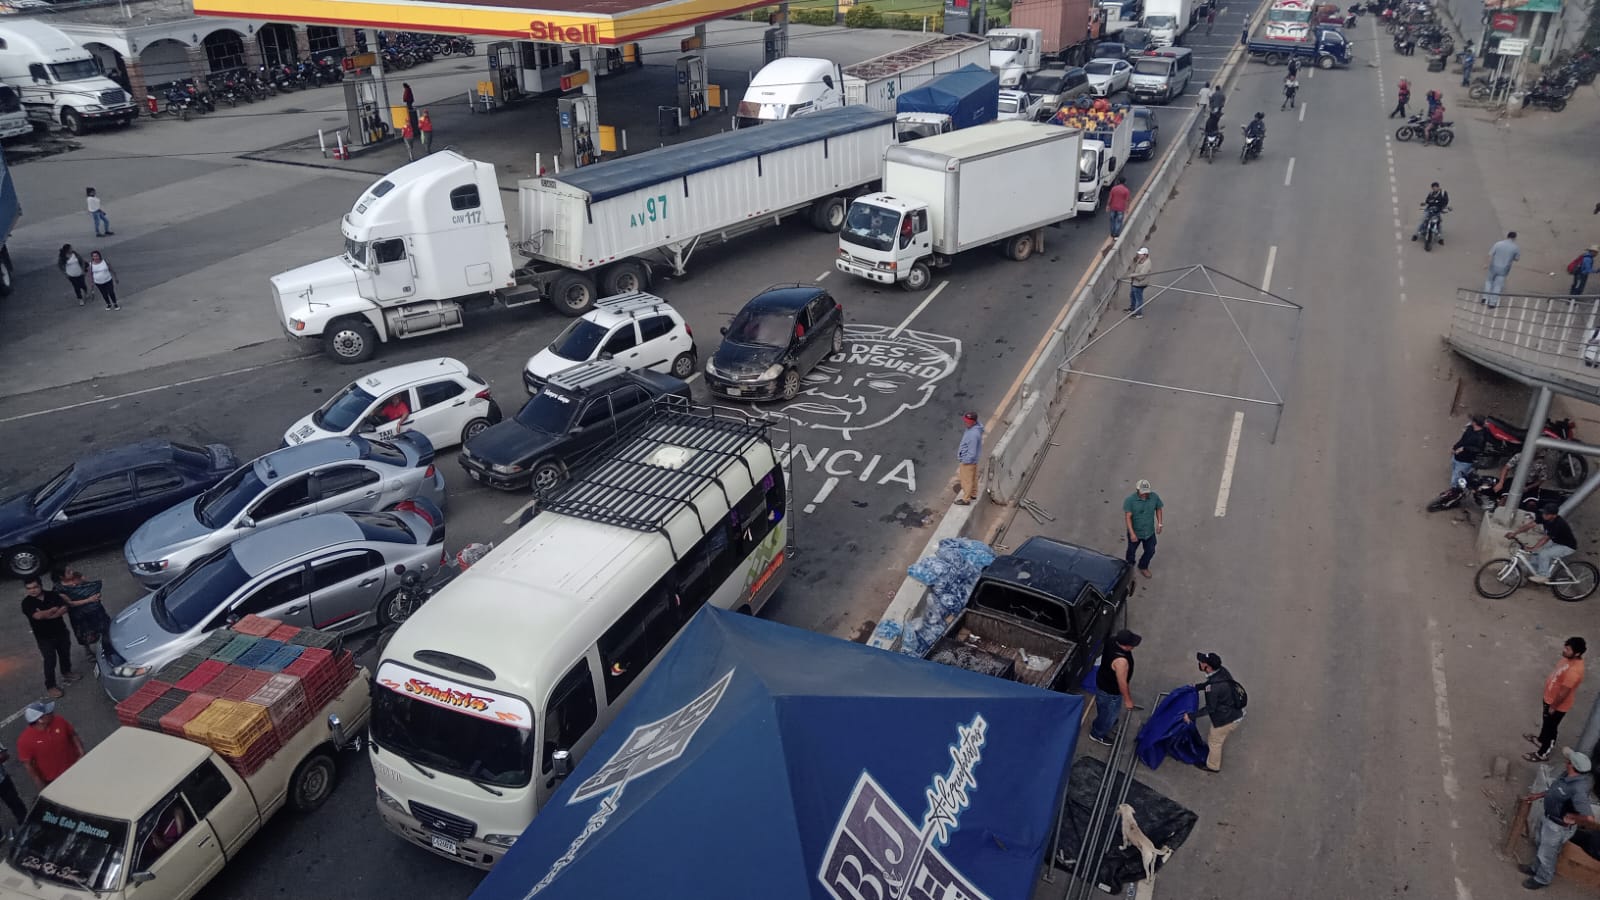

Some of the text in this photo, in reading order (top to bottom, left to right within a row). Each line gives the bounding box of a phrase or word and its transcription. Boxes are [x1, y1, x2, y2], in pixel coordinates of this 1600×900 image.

[529, 20, 598, 44] Shell
[452, 210, 482, 224] CAV 117
[630, 194, 667, 228] AV 97
[828, 352, 942, 379] ONSUELO
[380, 429, 393, 438] TAXI
[404, 678, 494, 711] Sandrita
